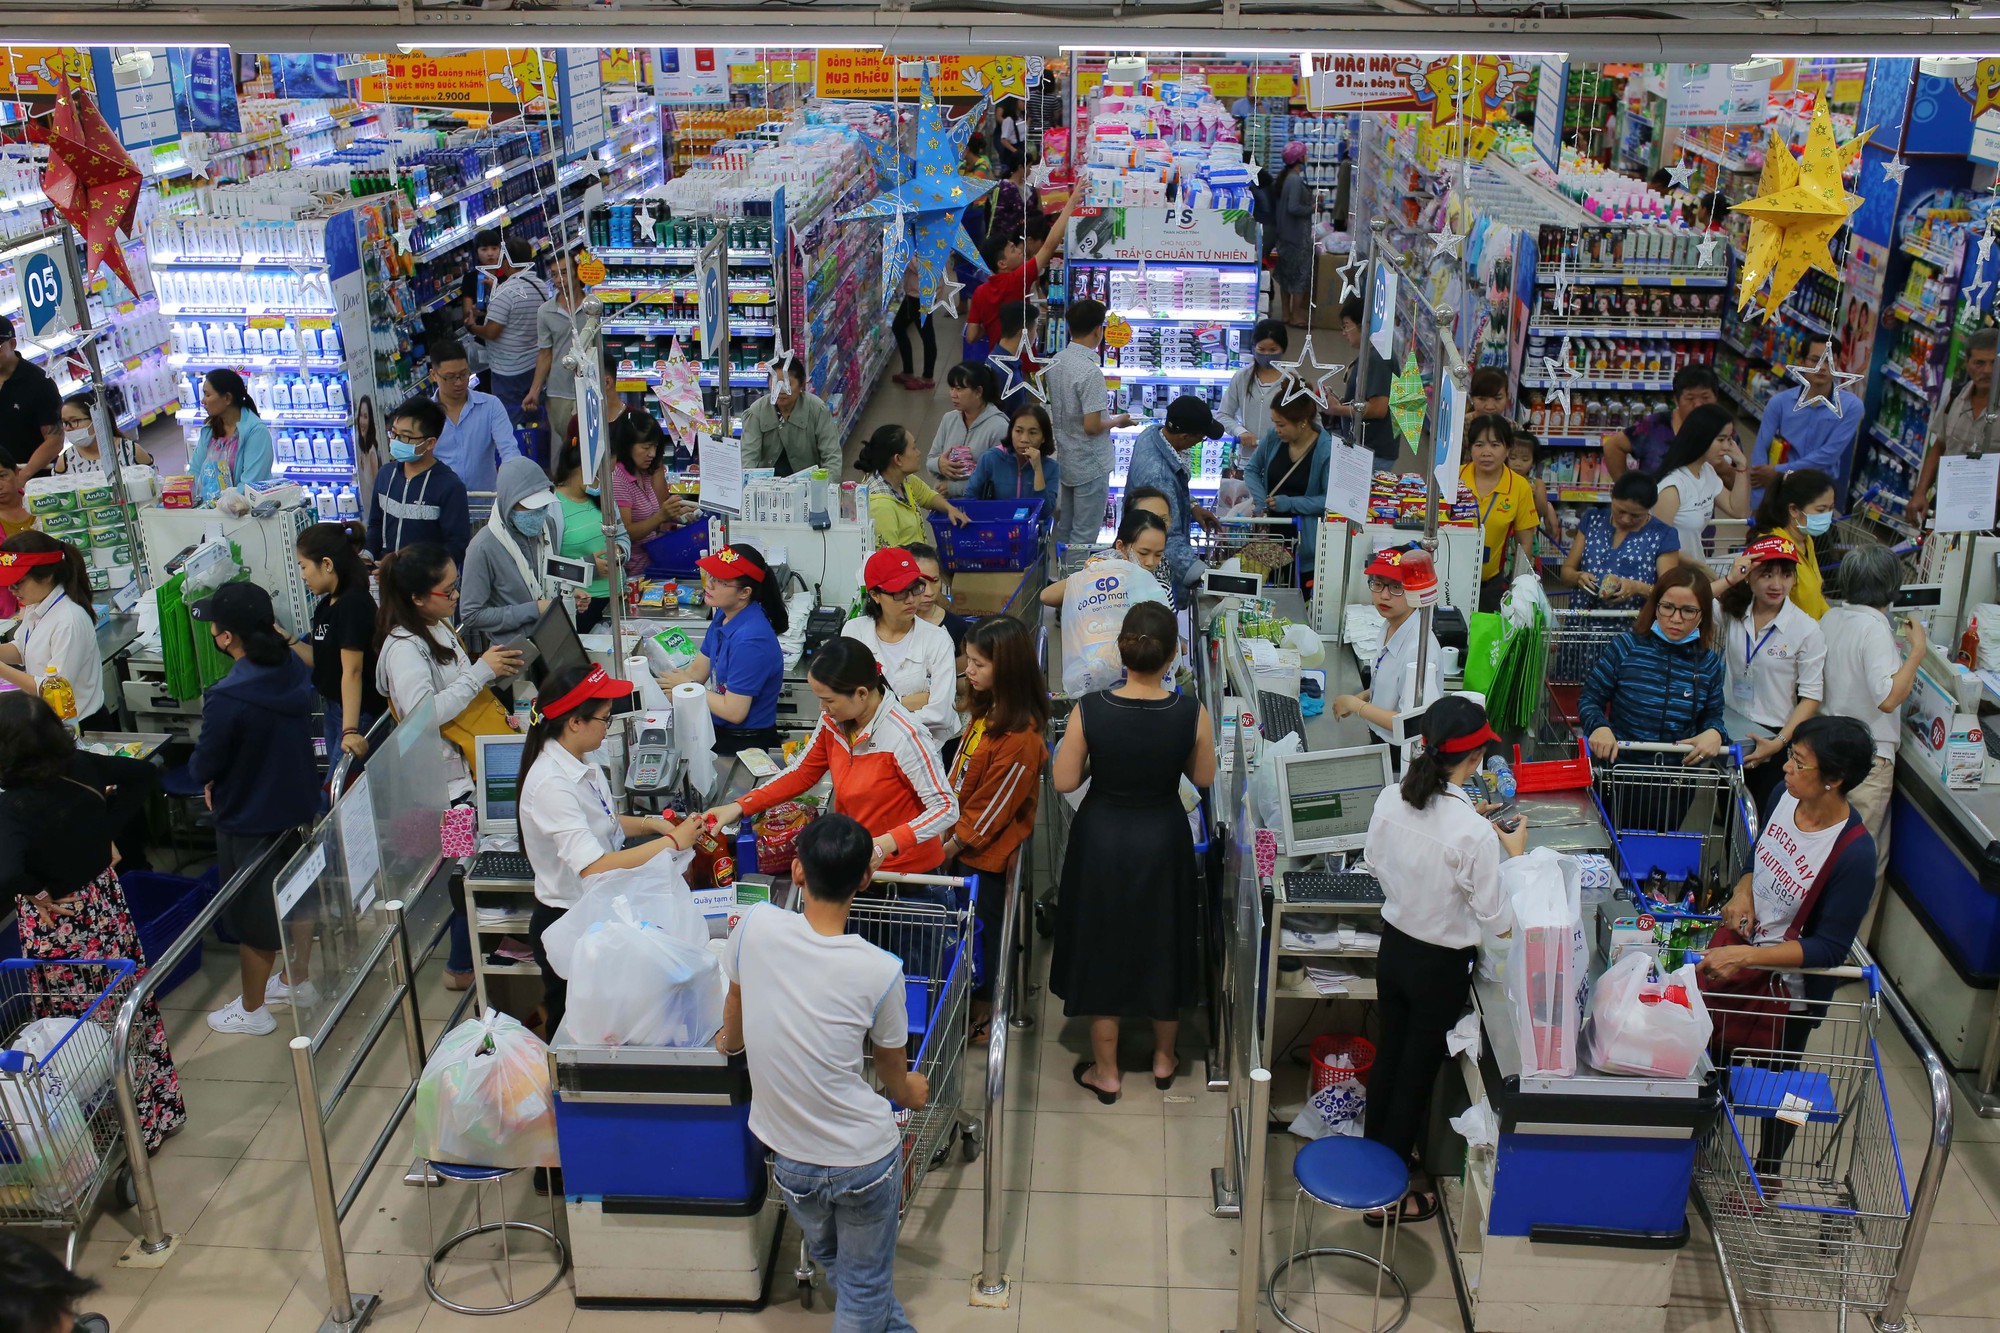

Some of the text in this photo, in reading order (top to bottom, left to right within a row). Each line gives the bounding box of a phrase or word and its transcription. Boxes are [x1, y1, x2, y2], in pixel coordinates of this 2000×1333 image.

[827, 54, 852, 67] Đồng
[855, 54, 880, 66] hành
[371, 59, 405, 78] ảm
[411, 60, 438, 79] giá
[826, 72, 850, 84] Mua
[854, 67, 889, 84] nhiều
[193, 76, 217, 86] MEN
[1335, 75, 1352, 88] 21
[1371, 76, 1396, 89] Đồng
[437, 92, 470, 101] 2.900đ
[1115, 245, 1248, 262] TRẮNG CHUẨN TỰ NHIÊN
[28, 265, 58, 307] 05
[342, 293, 361, 312] Dove
[706, 281, 717, 323] 07
[1374, 278, 1385, 320] 09
[36, 498, 56, 507] AnAn
[86, 491, 105, 499] AnAn
[48, 517, 68, 525] AnAn
[96, 510, 116, 518] AnAn
[96, 533, 115, 541] AnAn
[1767, 823, 1815, 881] ERCER BAY
[1760, 851, 1809, 900] AUTHORITY
[1770, 877, 1795, 906] 1992
[693, 895, 712, 905] Quầy
